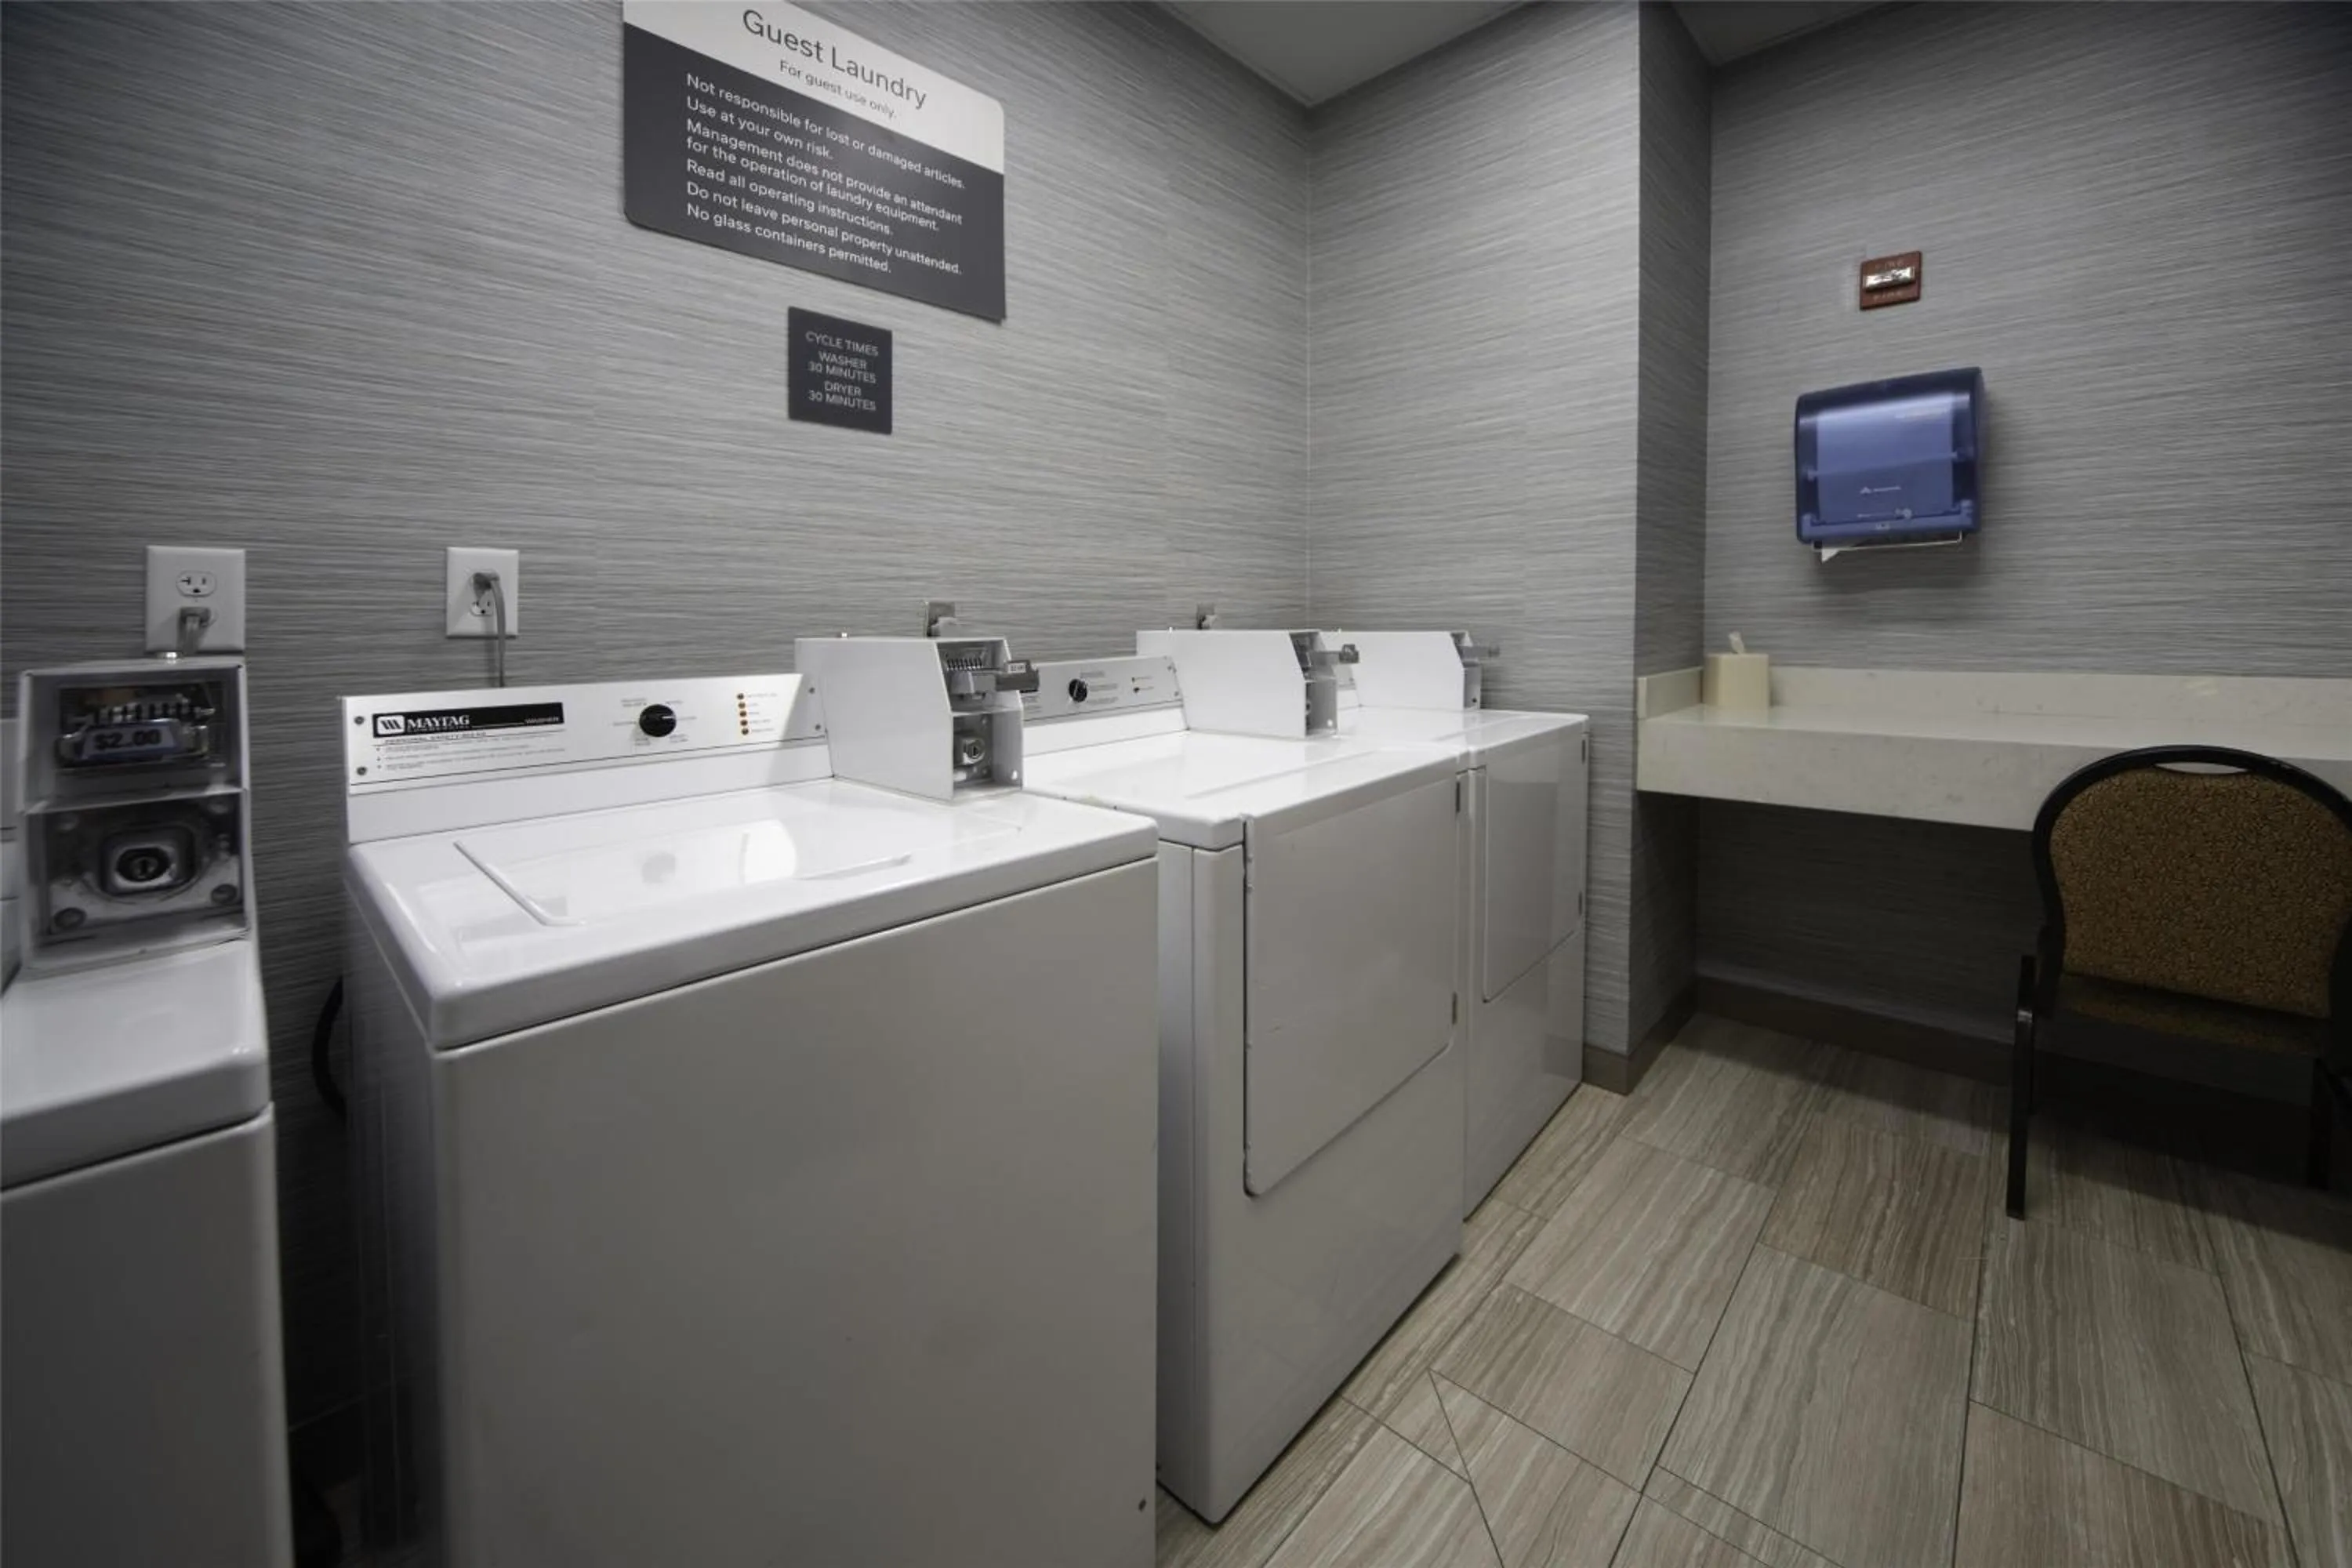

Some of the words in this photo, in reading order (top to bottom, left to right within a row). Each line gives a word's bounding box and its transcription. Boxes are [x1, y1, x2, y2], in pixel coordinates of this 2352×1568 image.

[742, 9, 823, 63] Guest
[832, 45, 927, 110] Laundry
[780, 60, 802, 76] For
[805, 73, 841, 95] guest
[844, 89, 866, 107] use
[869, 99, 896, 119] only.
[687, 96, 716, 118] Use
[720, 111, 734, 125] at
[737, 118, 771, 136] your
[774, 131, 803, 149] own
[807, 141, 833, 159] risk.
[687, 73, 715, 96] Not
[719, 89, 800, 128] responsible
[804, 118, 822, 136] for
[826, 127, 849, 147] lost
[852, 139, 865, 151] or
[868, 143, 921, 173] damaged
[924, 166, 965, 189] articles.
[687, 118, 783, 163] Management
[786, 155, 818, 175] does
[822, 167, 843, 183] not
[846, 176, 891, 200] provide
[893, 193, 908, 205] an
[910, 198, 963, 225] attendant
[687, 136, 709, 154] for
[713, 146, 736, 164] the
[740, 158, 807, 187] operation
[810, 180, 823, 193] of
[826, 183, 873, 211] laundry
[875, 202, 939, 231] equipment.
[687, 158, 725, 182] Read
[728, 175, 746, 189] all
[749, 181, 815, 212] operating
[818, 201, 893, 235] instructions.
[687, 180, 710, 198] Do
[713, 191, 738, 209] not
[741, 198, 778, 220] leave
[782, 213, 838, 238] personal
[841, 230, 893, 256] property
[895, 248, 962, 274] unattended.
[687, 201, 710, 220] No
[713, 213, 752, 233] glass
[755, 226, 826, 254] containers
[829, 247, 891, 273] permitted.
[805, 330, 843, 349] CYCLE
[844, 339, 879, 357] TIMES
[808, 360, 822, 372] 30
[826, 365, 876, 383] MINUTES
[818, 350, 867, 369] WASHER
[808, 390, 822, 402] 30
[826, 394, 877, 411] MINUTES
[824, 380, 862, 397] DRYER
[406, 715, 470, 729] MAYTAG
